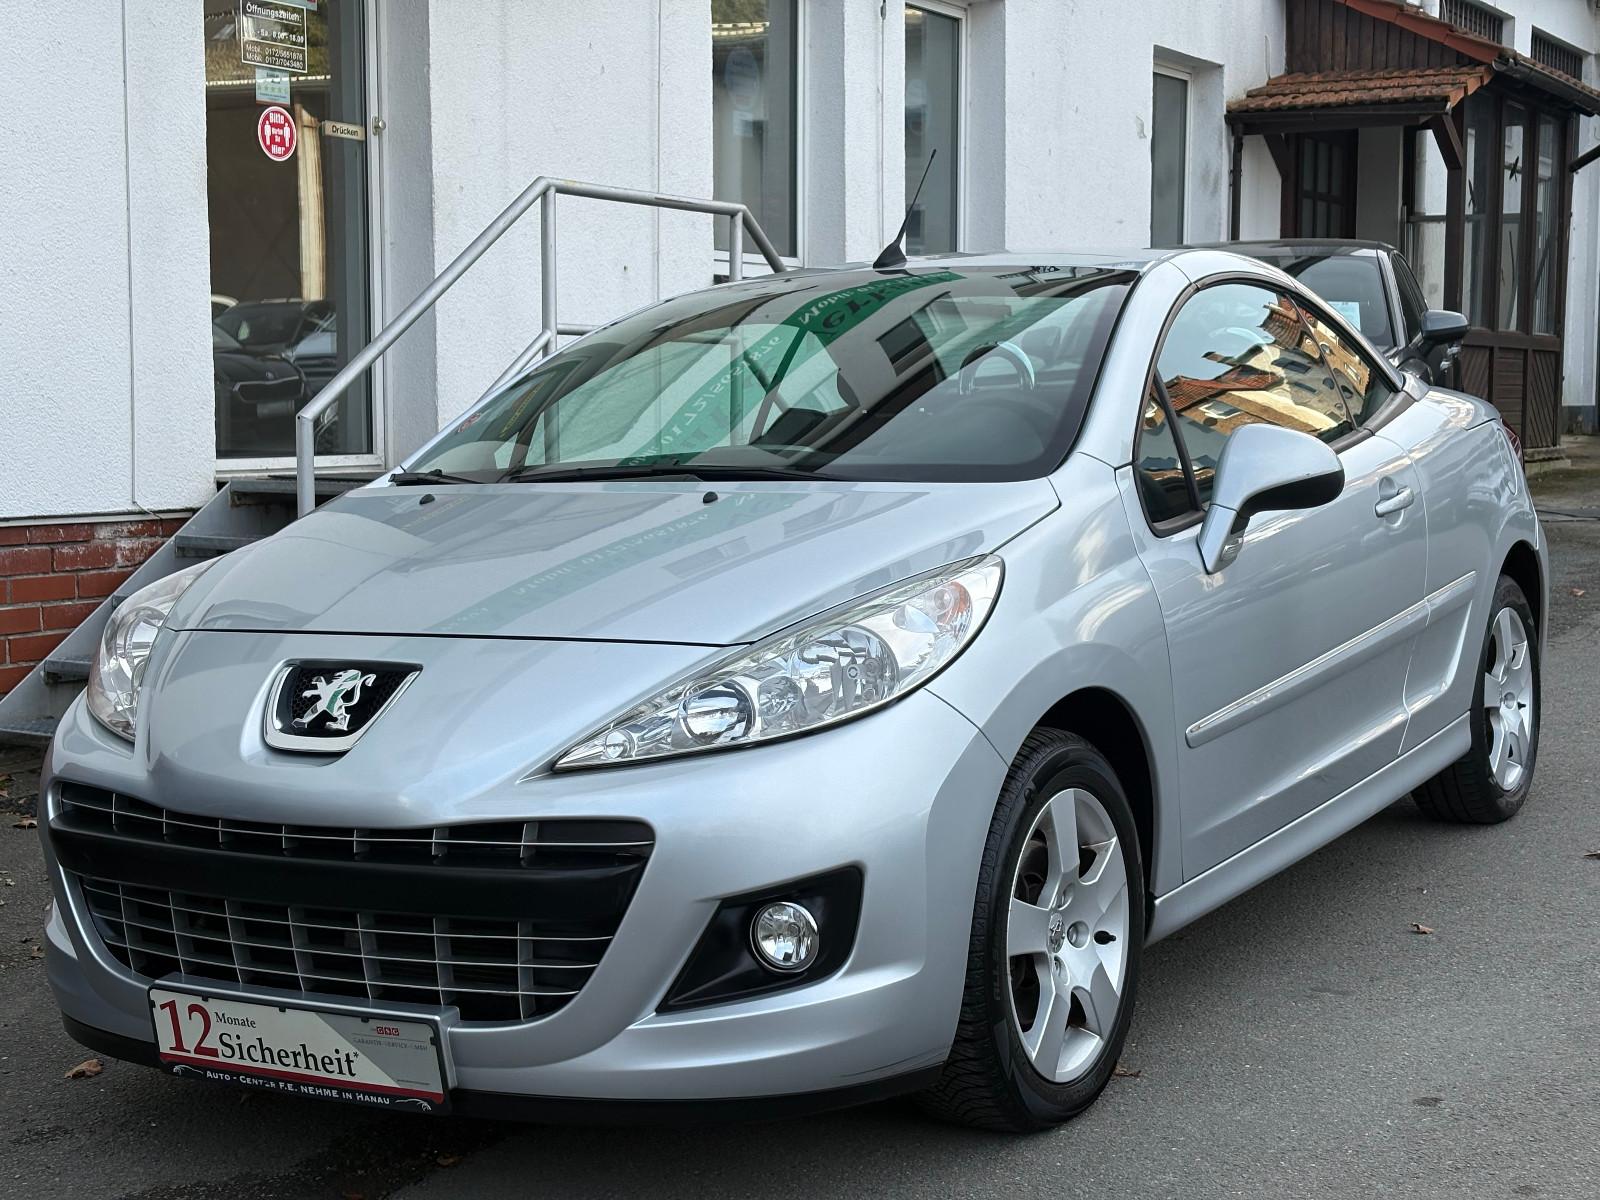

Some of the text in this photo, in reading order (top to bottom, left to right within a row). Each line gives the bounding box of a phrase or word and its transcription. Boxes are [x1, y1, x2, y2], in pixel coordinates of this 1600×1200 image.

[331, 124, 359, 137] Drücken
[159, 999, 219, 1058] 12
[214, 1011, 257, 1029] Monate
[206, 1070, 231, 1081] AUTO
[279, 1082, 298, 1092] F.E.
[301, 1085, 339, 1098] NEHME
[342, 1091, 353, 1100] IN
[356, 1092, 390, 1105] HANAU
